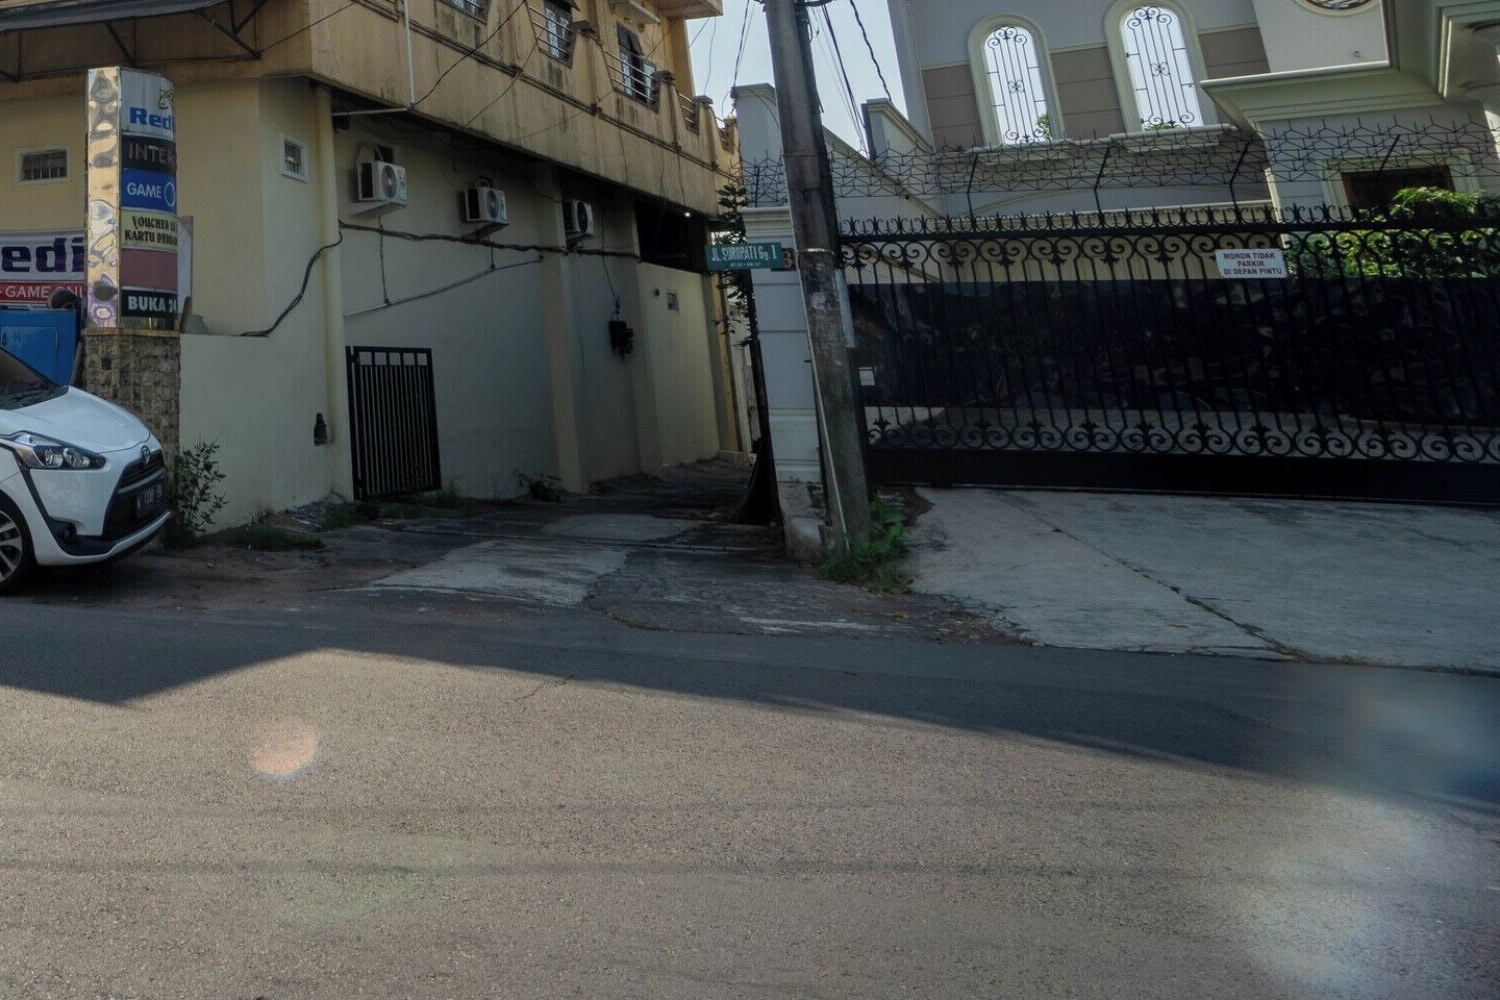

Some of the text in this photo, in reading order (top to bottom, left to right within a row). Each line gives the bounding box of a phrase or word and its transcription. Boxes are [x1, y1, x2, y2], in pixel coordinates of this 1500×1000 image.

[127, 182, 162, 199] GAME
[132, 215, 169, 230] VOUCHER
[125, 229, 155, 242] KARTU
[722, 245, 757, 260] SUROPATI
[5, 285, 51, 298] GAME
[128, 295, 166, 311] BUKA
